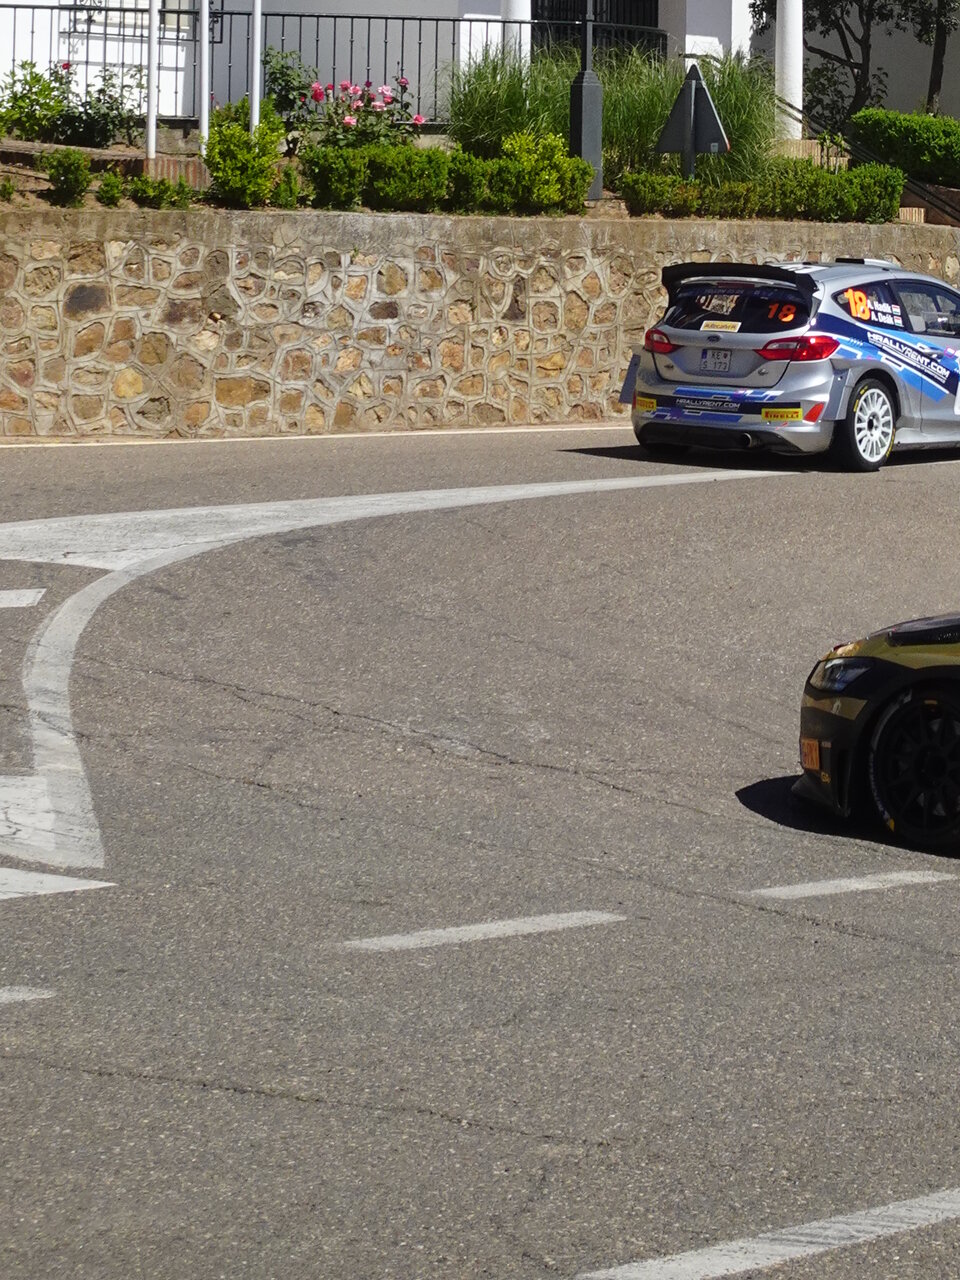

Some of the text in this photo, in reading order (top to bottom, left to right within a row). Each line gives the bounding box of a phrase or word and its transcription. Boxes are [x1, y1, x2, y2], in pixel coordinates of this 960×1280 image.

[767, 303, 797, 322] 18
[844, 288, 871, 320] 18
[867, 331, 950, 378] HRALLYRENT.COM
[764, 410, 799, 419] PIRELLI
